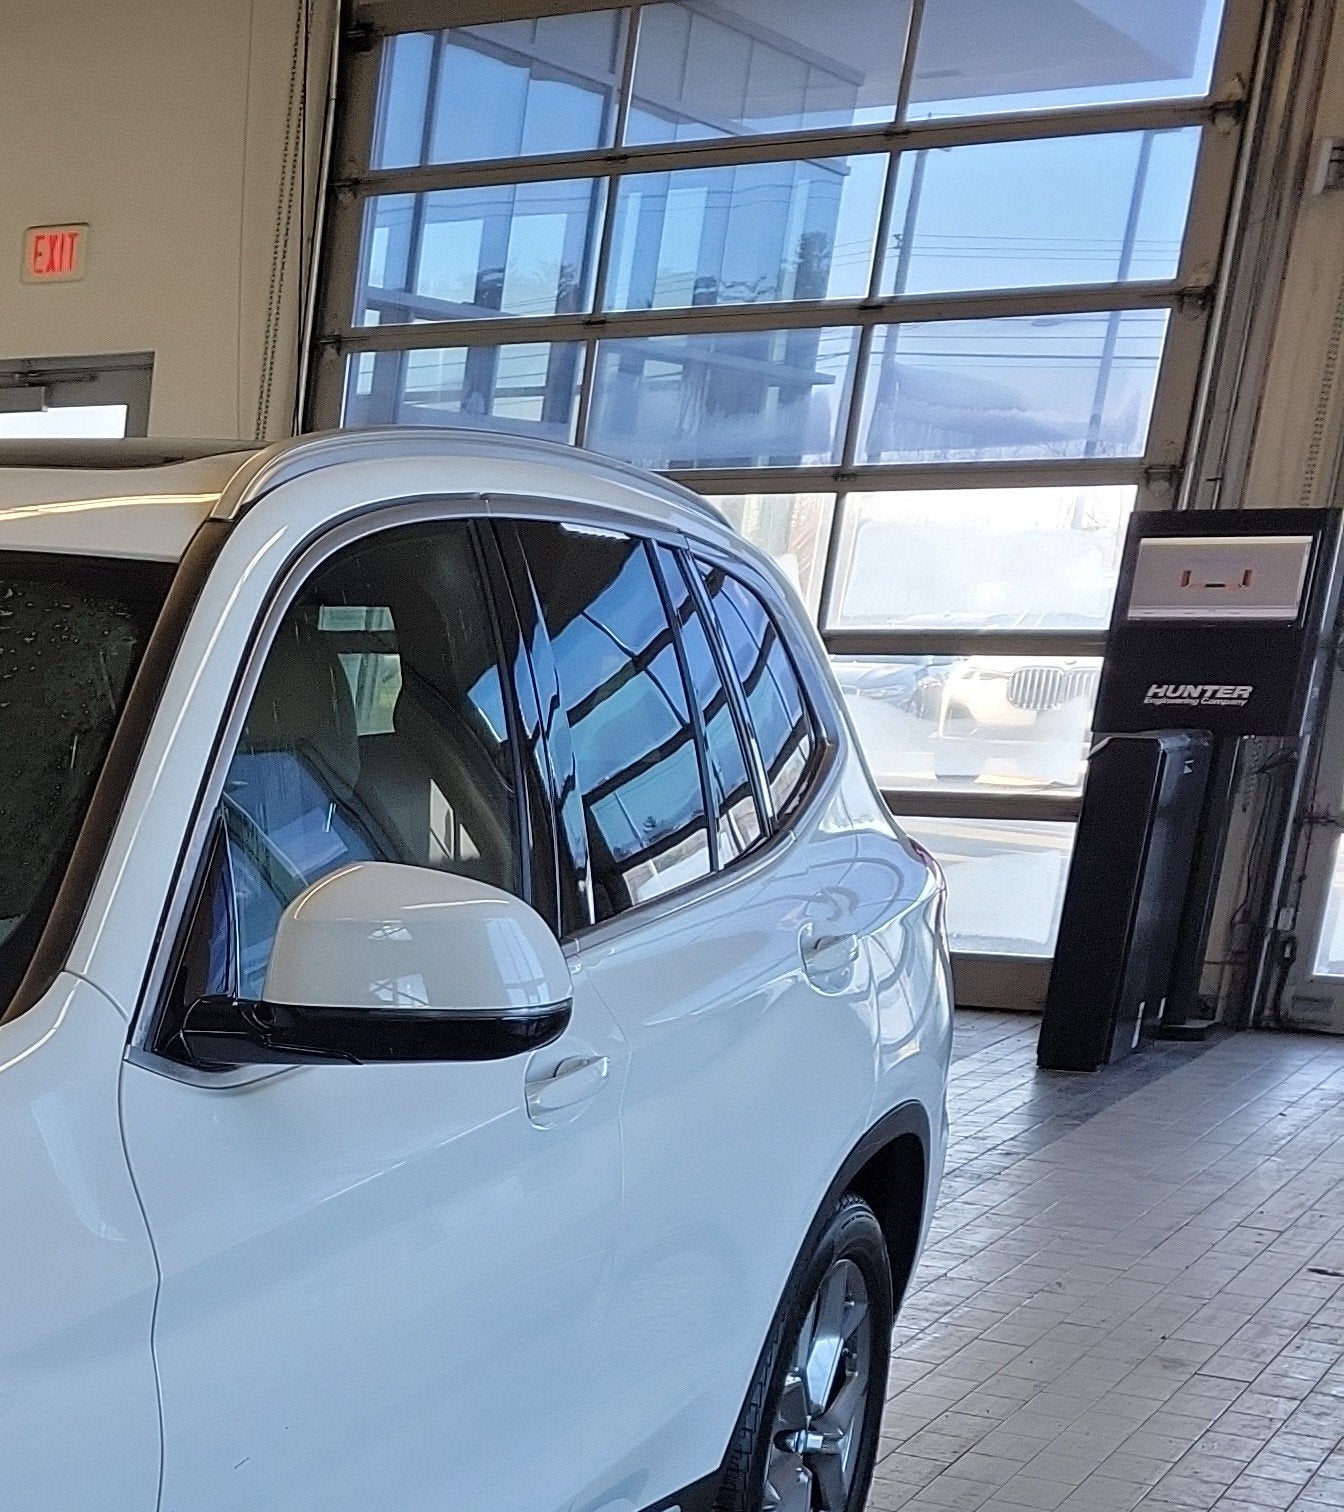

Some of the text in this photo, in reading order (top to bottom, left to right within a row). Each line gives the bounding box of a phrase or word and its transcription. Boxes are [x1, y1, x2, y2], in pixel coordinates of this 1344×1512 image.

[33, 232, 78, 274] EXIT
[1147, 684, 1253, 698] HUNTER
[1143, 697, 1249, 707] Engineering Company
